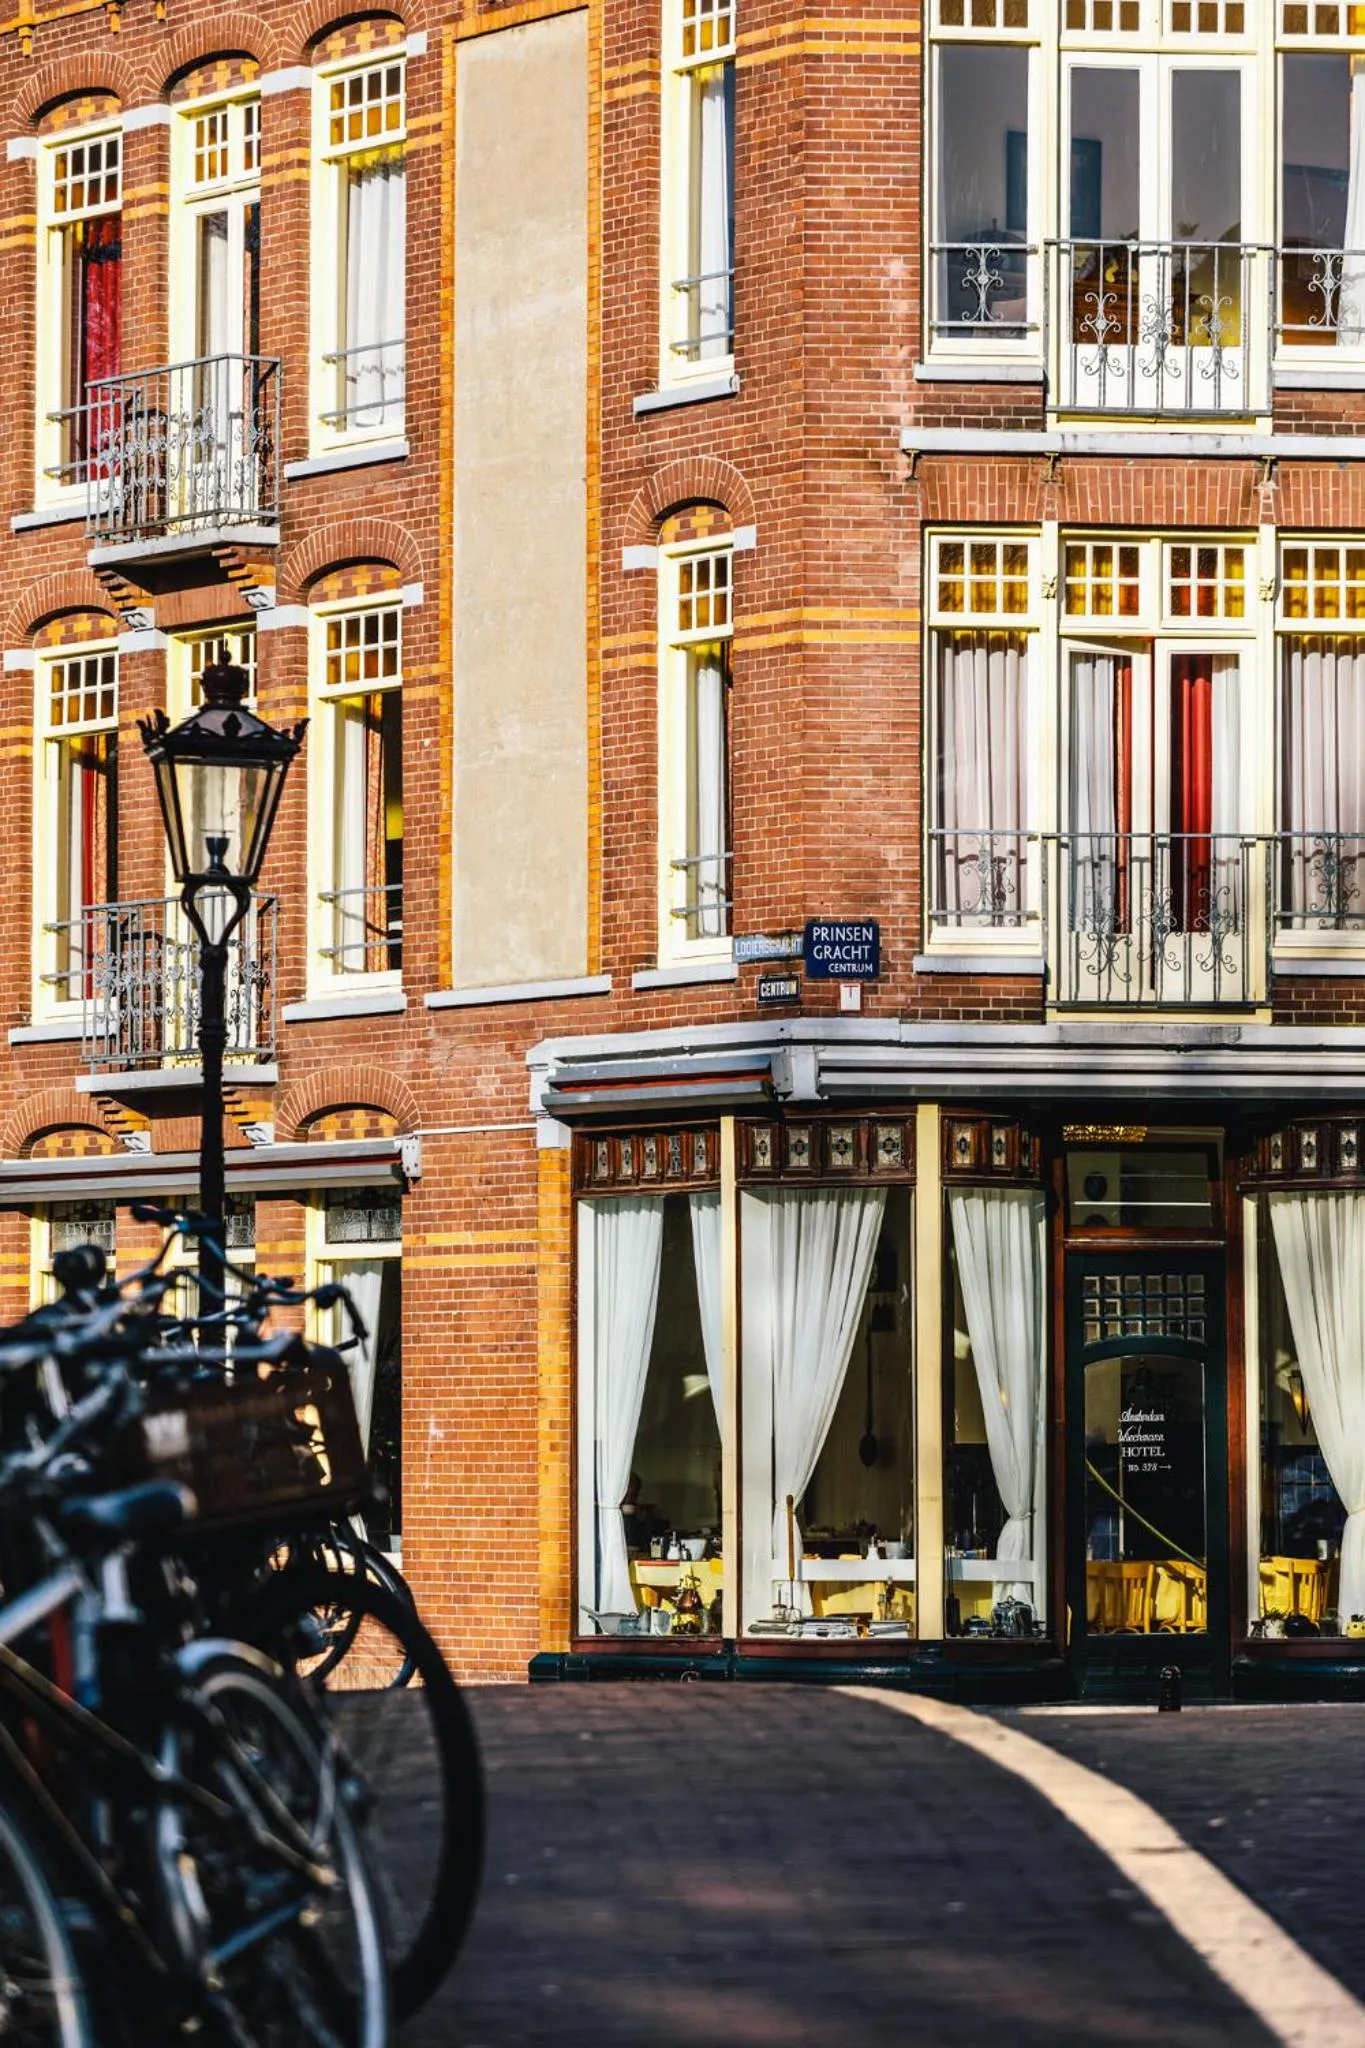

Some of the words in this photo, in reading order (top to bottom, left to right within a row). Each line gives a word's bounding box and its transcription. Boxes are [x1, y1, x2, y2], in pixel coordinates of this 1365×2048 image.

[812, 926, 873, 942] PRINSEN
[812, 945, 870, 960] GRACHT
[828, 963, 873, 973] CENTRUM
[760, 981, 797, 997] CENTRUM
[1121, 1446, 1165, 1458] HOTEL
